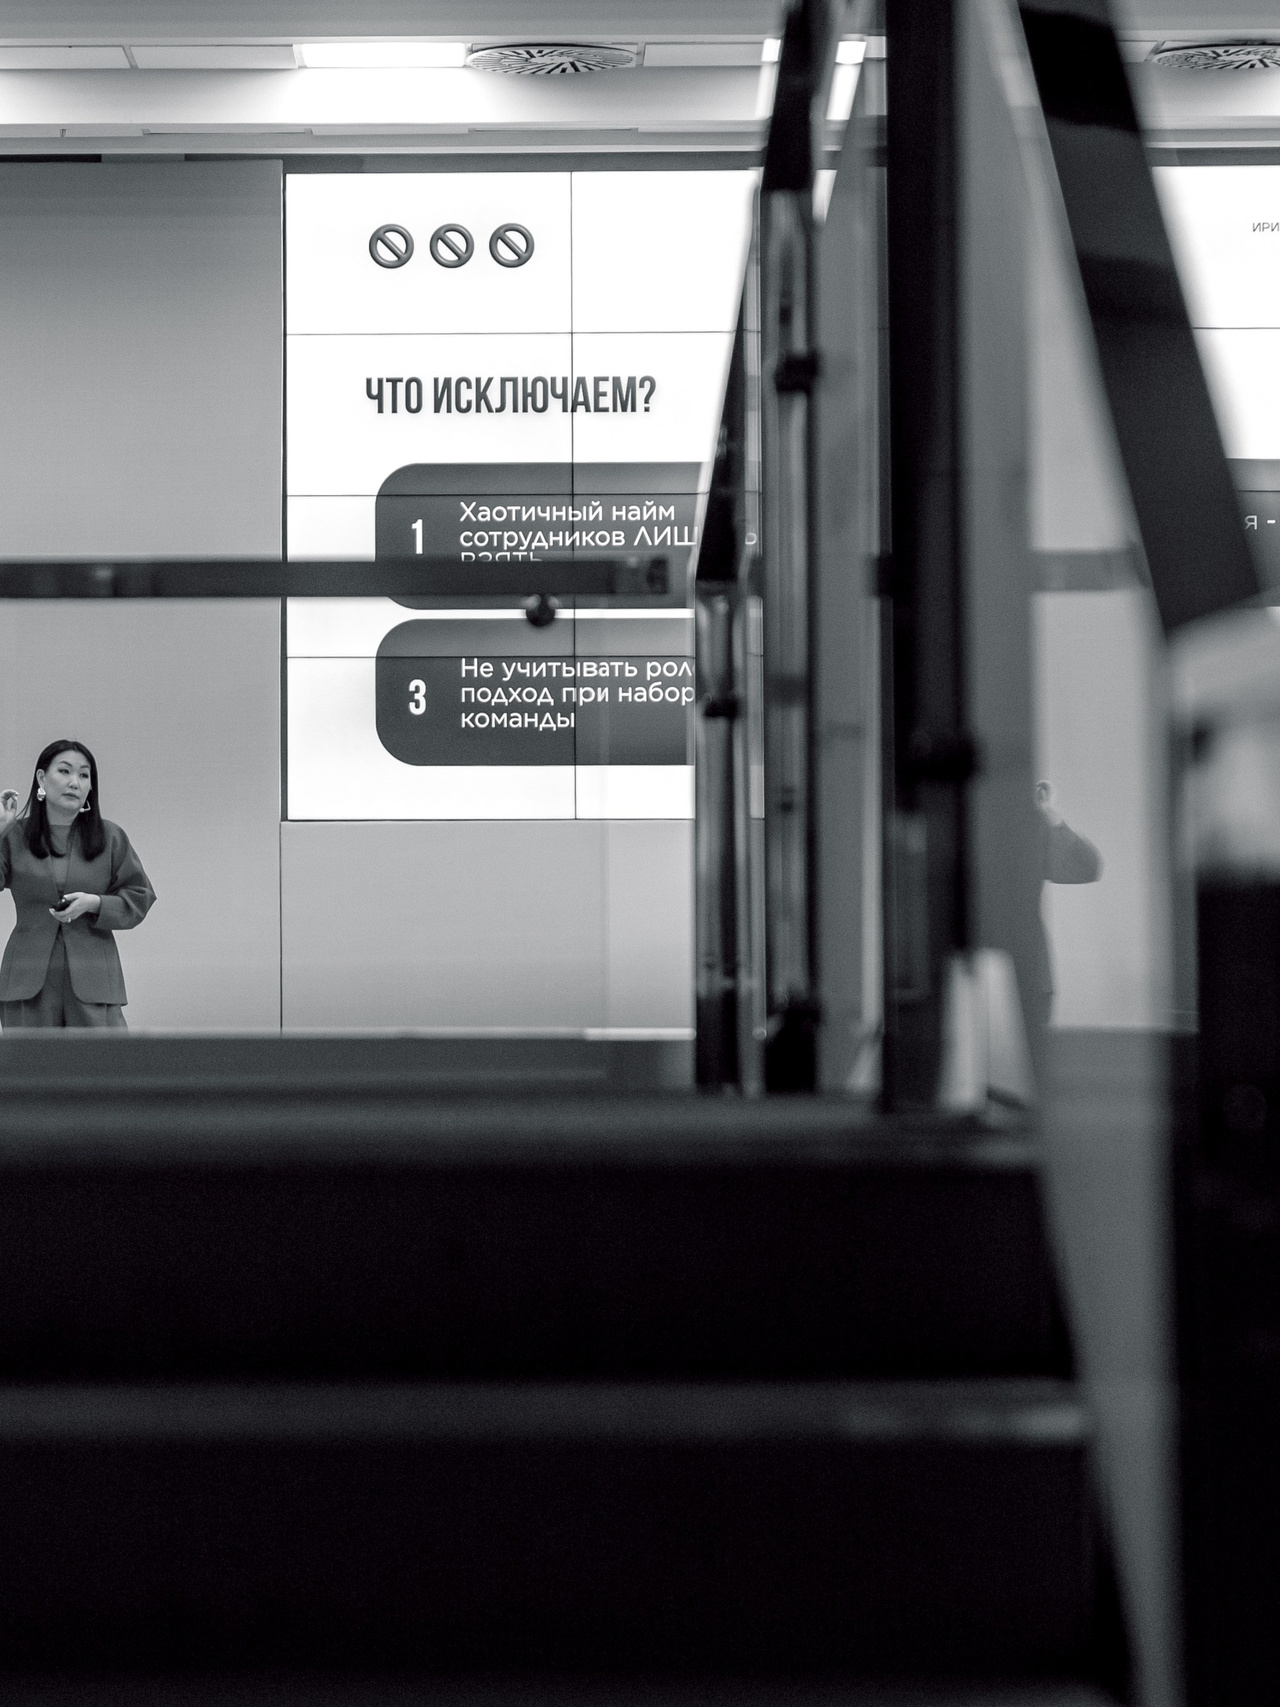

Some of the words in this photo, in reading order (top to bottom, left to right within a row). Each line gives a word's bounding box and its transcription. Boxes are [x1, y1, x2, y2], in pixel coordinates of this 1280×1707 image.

[1252, 222, 1280, 233] ИРИ
[365, 376, 424, 414] ЧТО
[432, 375, 657, 414] ИСКЛЮЧАЕМ?
[459, 500, 604, 522] Хаотичный
[612, 500, 676, 522] найм
[411, 518, 424, 555] 1
[459, 530, 626, 550] сотрудников
[633, 525, 699, 547] ЛИШ
[461, 657, 494, 678] Не
[502, 661, 638, 682] учитывать
[646, 661, 695, 681] рол
[408, 678, 428, 716] 3
[461, 686, 554, 706] подход
[562, 686, 609, 706] при
[618, 681, 696, 706] набор
[461, 712, 576, 732] команды
